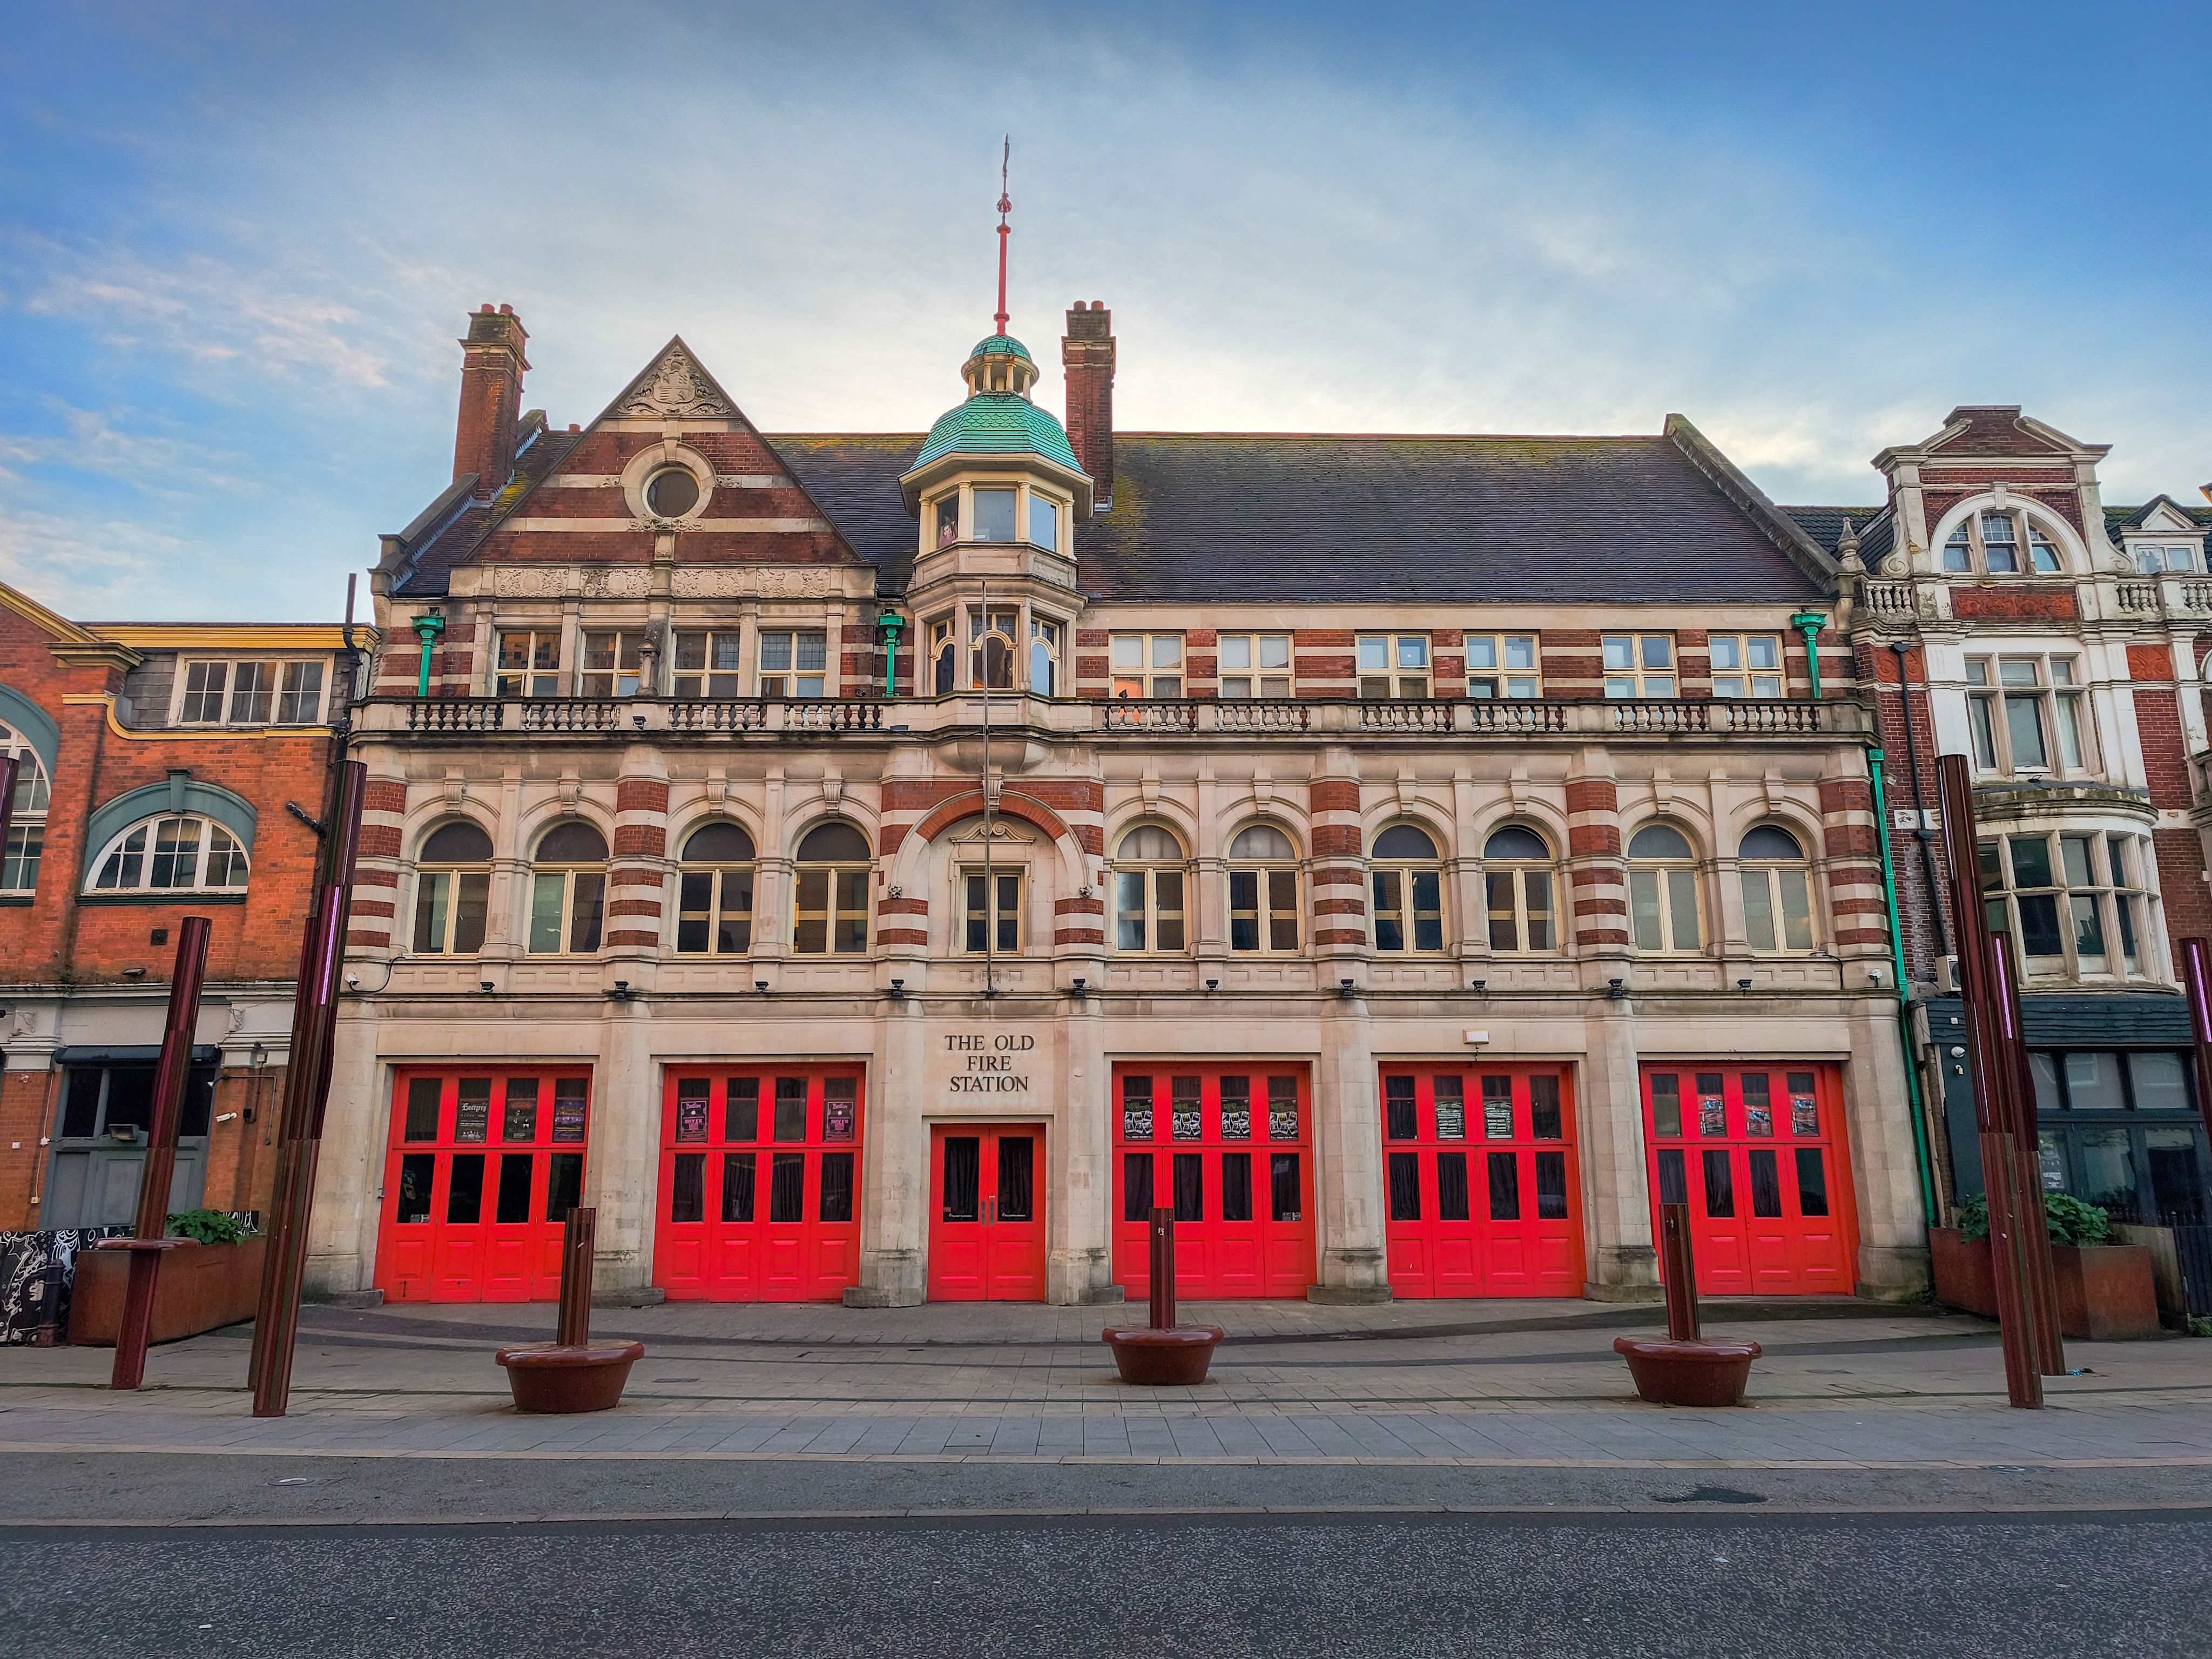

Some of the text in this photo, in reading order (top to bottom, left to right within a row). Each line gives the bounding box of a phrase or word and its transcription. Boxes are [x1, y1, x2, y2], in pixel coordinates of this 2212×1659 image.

[945, 1035, 1034, 1050] THE OLD
[967, 1056, 1012, 1071] FIRE
[950, 1076, 1029, 1091] STATION
